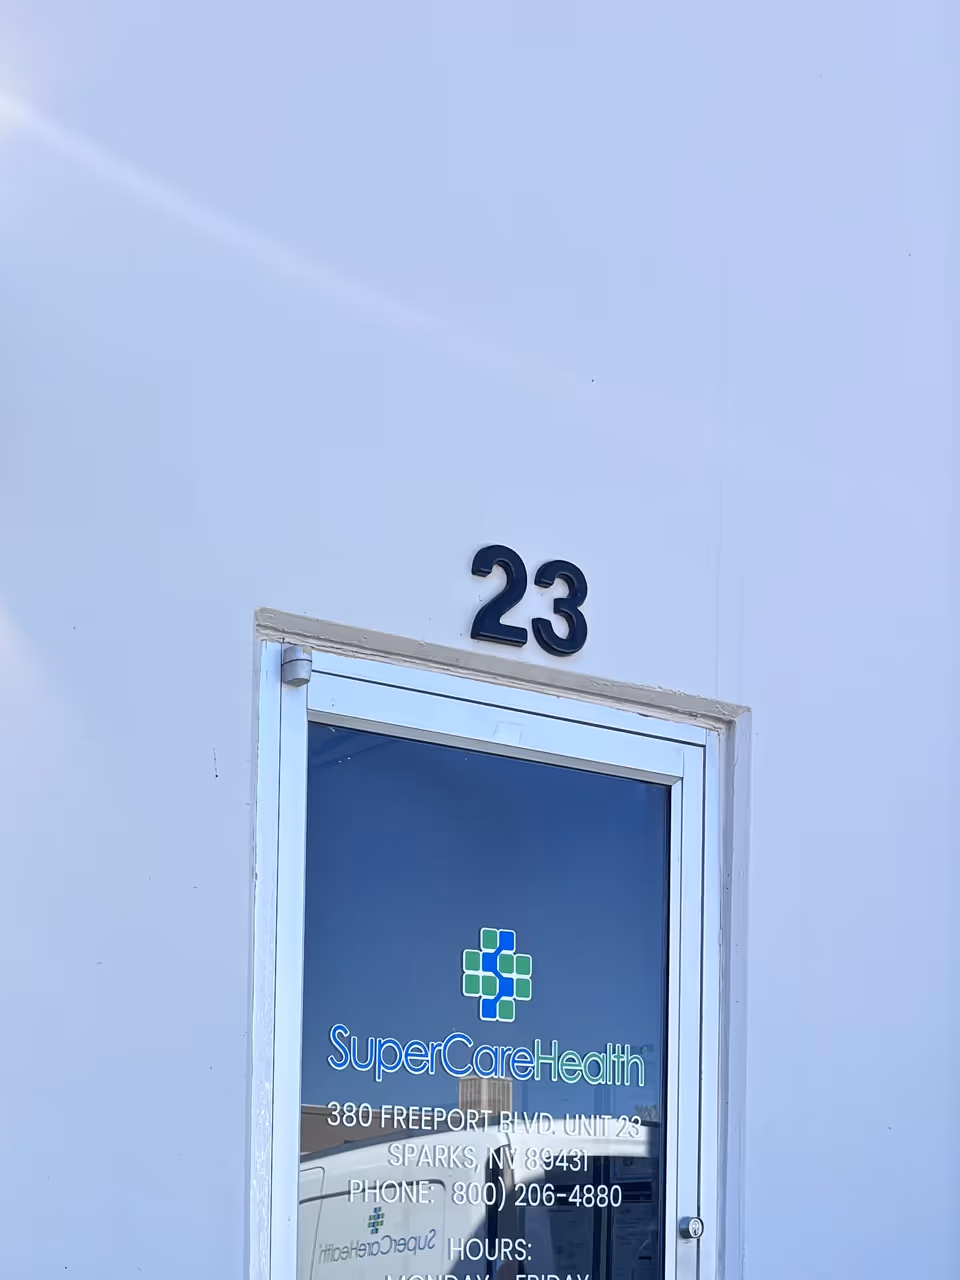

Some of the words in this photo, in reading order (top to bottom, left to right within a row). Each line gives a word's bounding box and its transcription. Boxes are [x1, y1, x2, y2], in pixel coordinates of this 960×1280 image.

[470, 544, 588, 657] 23
[327, 1101, 373, 1127] 380
[381, 1105, 493, 1132] FREEPORT
[499, 1111, 555, 1136] BLVD.
[565, 1114, 612, 1137] UNIT
[617, 1115, 642, 1138] 23
[387, 1143, 480, 1173] SPARKS,
[489, 1147, 519, 1171] NV
[524, 1148, 589, 1172] 89431
[348, 1179, 435, 1205] PHONE:
[514, 1183, 623, 1208] 206-4880
[448, 1238, 532, 1261] HOURS:
